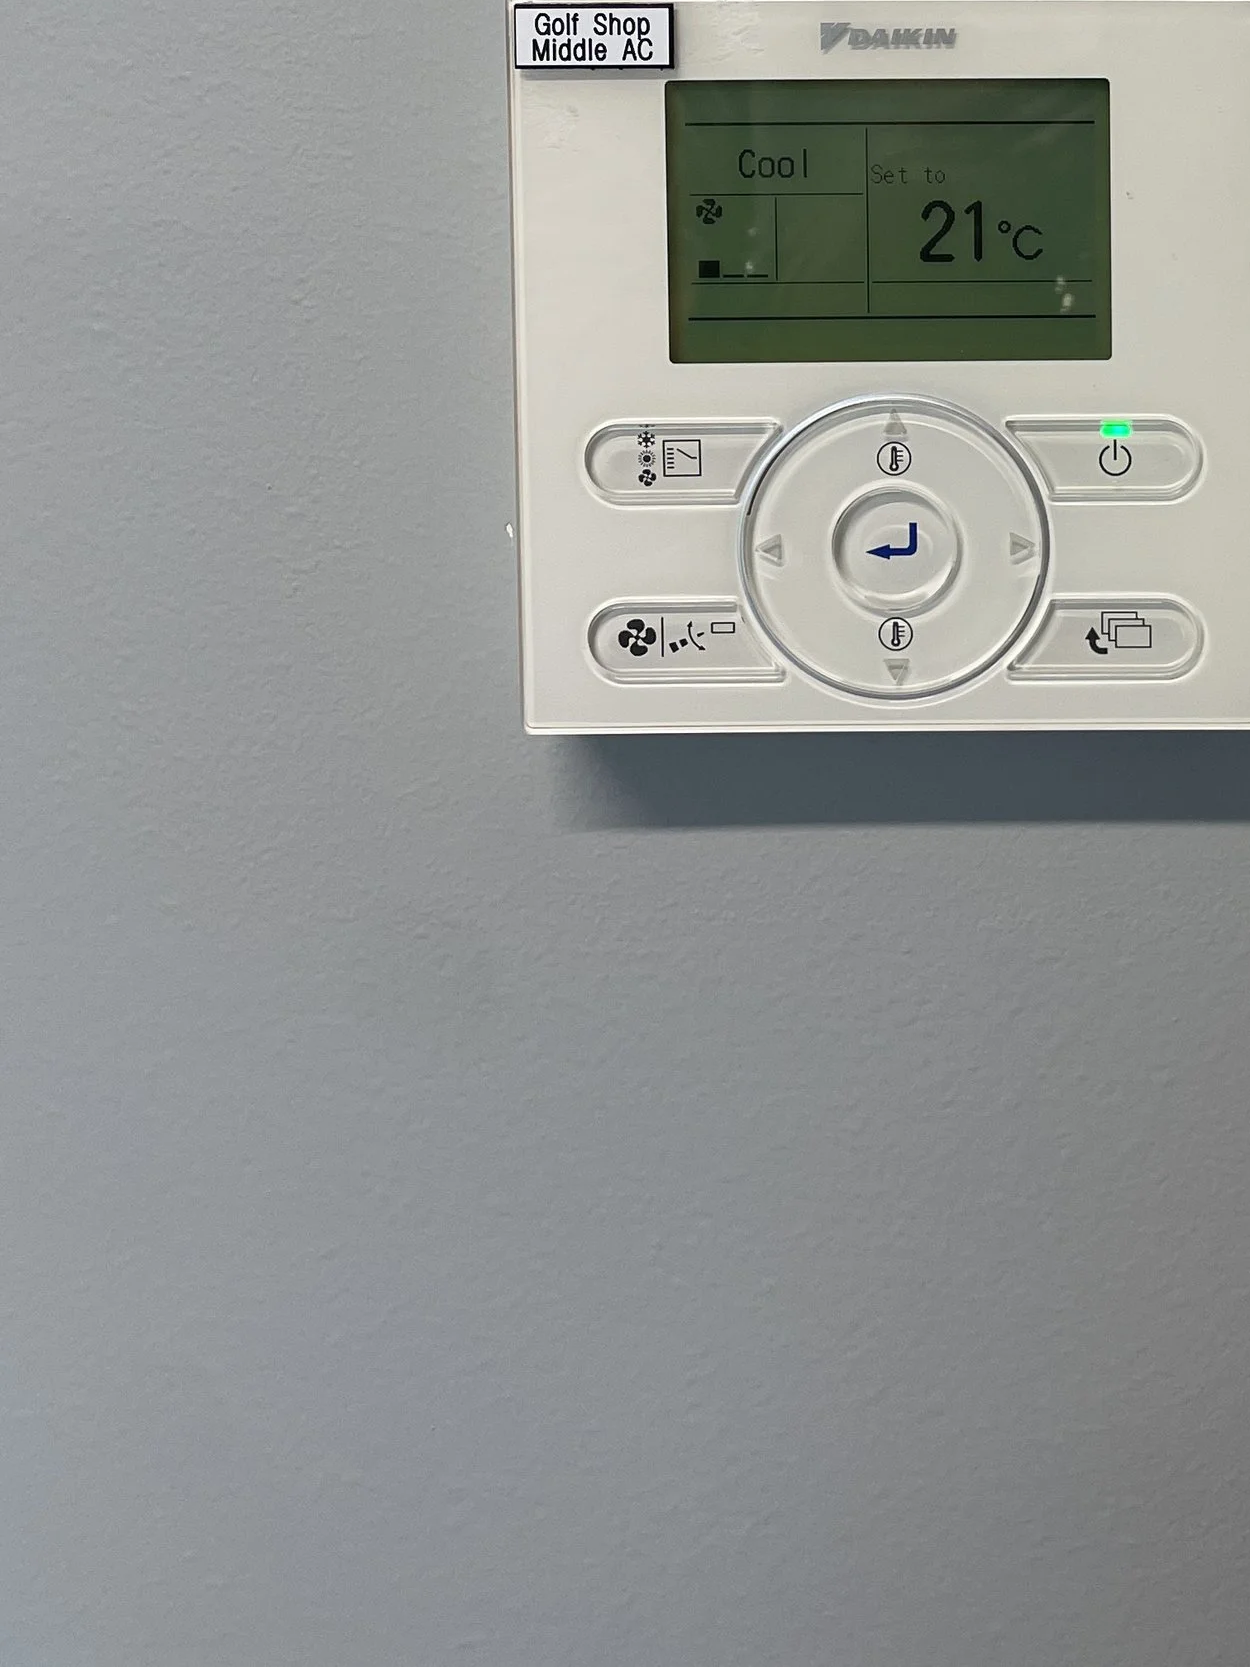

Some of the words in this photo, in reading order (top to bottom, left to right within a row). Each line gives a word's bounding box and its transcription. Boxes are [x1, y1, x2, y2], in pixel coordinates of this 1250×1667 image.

[534, 13, 581, 36] Golf
[593, 13, 651, 43] Shop
[847, 27, 957, 50] DAIKIN
[531, 38, 608, 62] Middle
[622, 38, 654, 62] AC
[738, 150, 809, 180] Cool
[870, 166, 908, 184] Set
[924, 166, 946, 184] to
